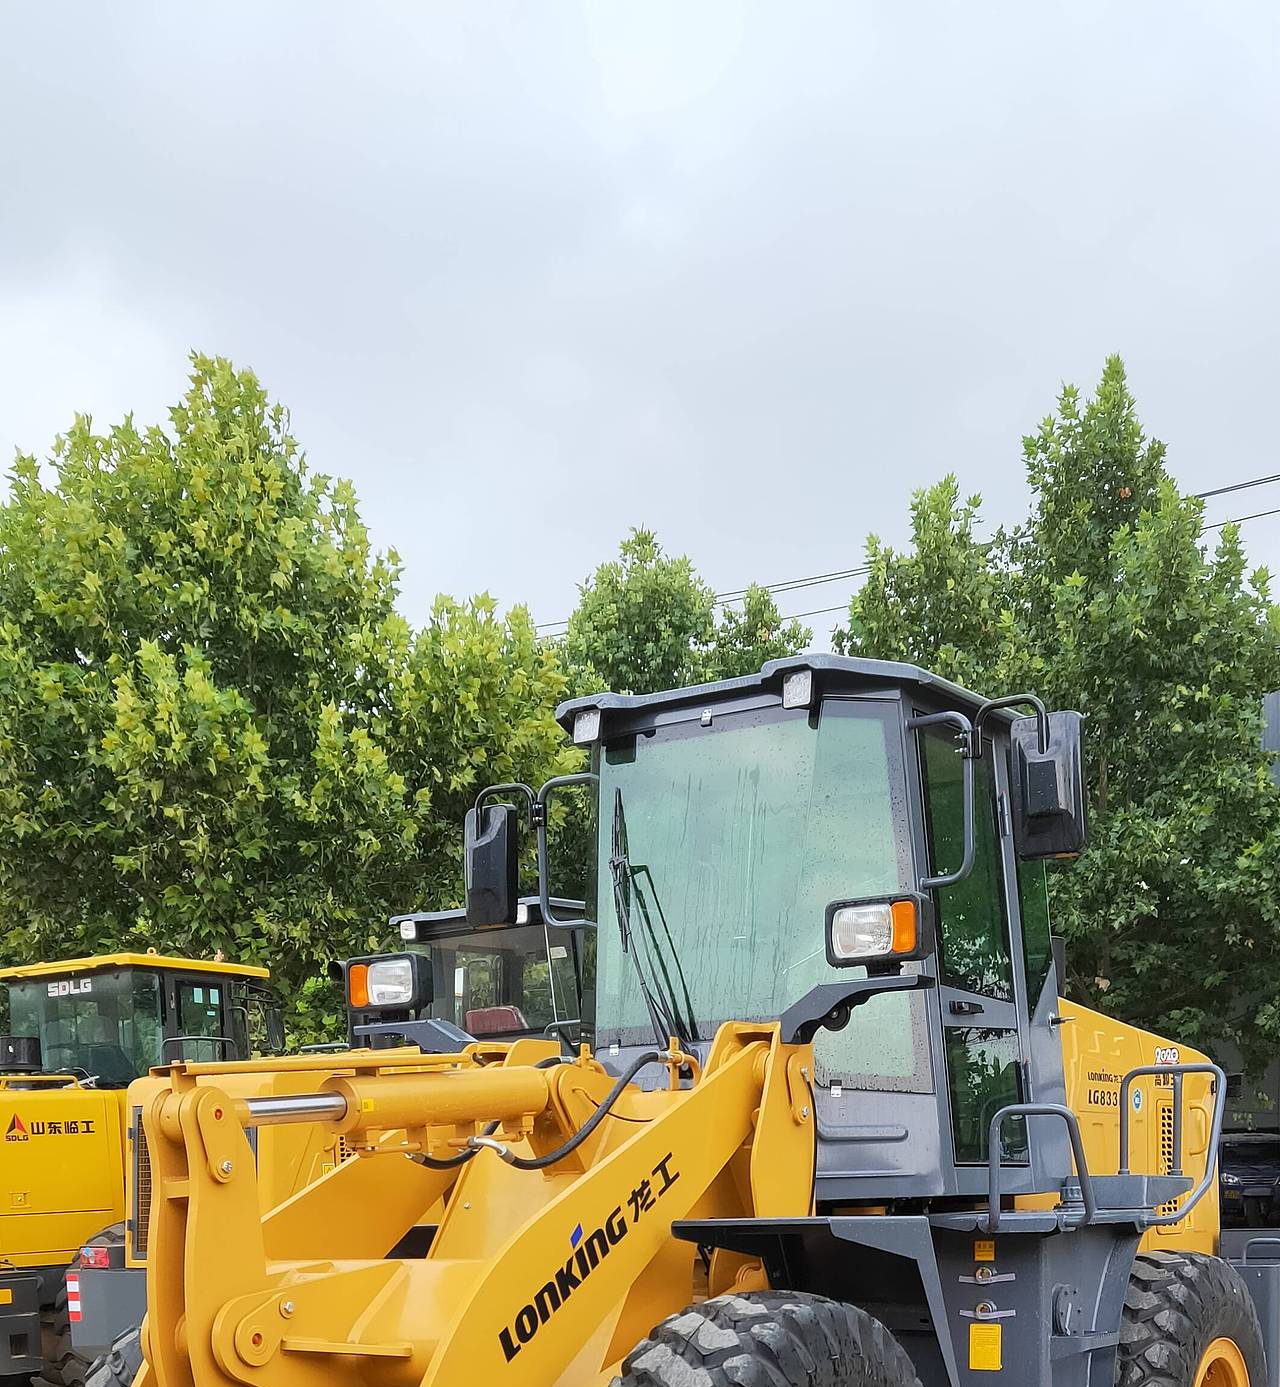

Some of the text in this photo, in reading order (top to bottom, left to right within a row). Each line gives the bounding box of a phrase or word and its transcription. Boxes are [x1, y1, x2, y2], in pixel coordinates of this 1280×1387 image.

[47, 978, 92, 997] SDLG
[1155, 1046, 1179, 1063] 2020
[1088, 1068, 1113, 1083] LONKING
[1088, 1089, 1118, 1107] LG833
[30, 1120, 95, 1135] 山东临工
[5, 1134, 29, 1142] SDLG
[498, 1152, 680, 1364] LONKING 龙工
